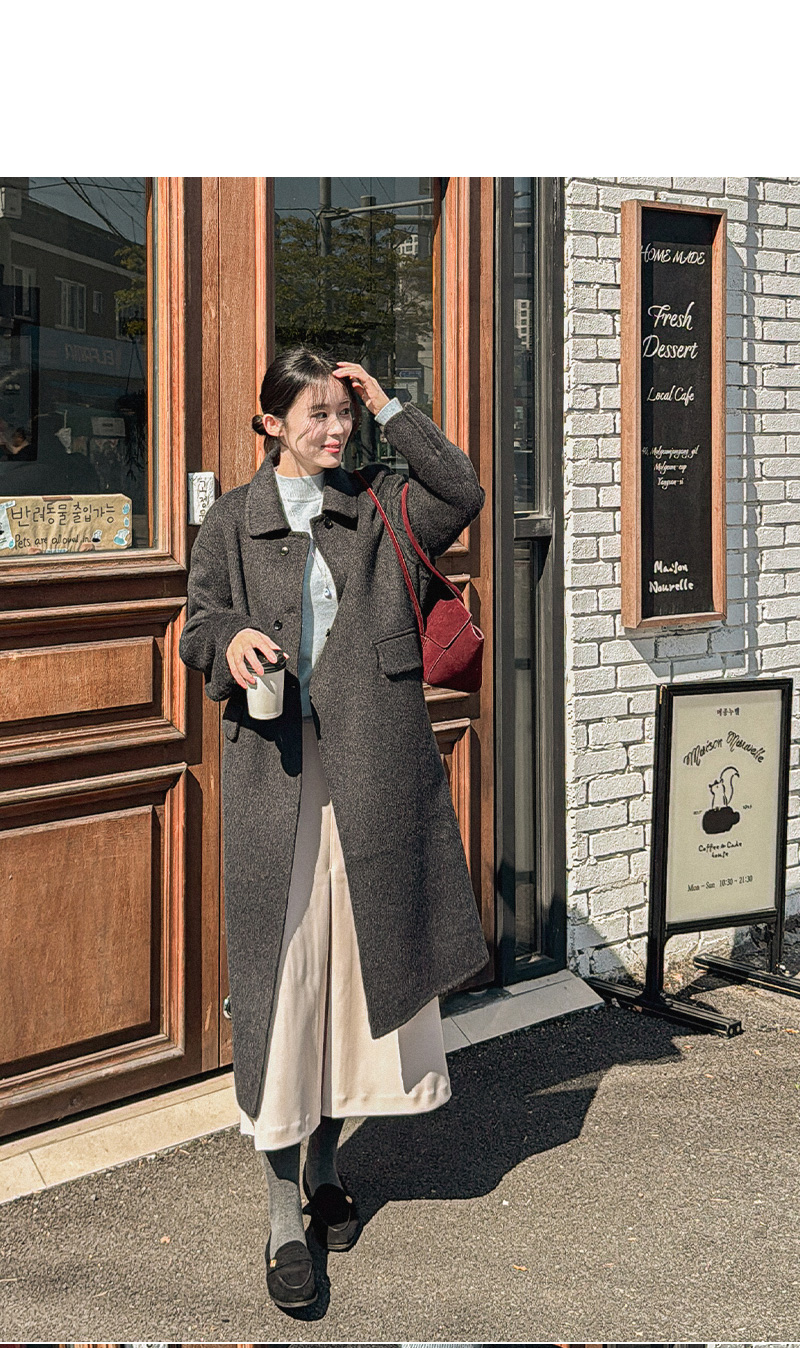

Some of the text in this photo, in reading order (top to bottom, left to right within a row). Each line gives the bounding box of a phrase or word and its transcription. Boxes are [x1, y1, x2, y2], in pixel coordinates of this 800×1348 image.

[641, 242, 706, 265] HOME MADE
[647, 301, 694, 331] Fresh
[642, 334, 699, 360] Dessert
[646, 385, 695, 407] Local Cafe
[10, 501, 116, 528] 반려동물 출입가능
[14, 533, 31, 550] Pets
[34, 537, 48, 546] are
[654, 560, 689, 574] Maison
[683, 738, 723, 767] Maison
[698, 843, 720, 853] Coffee
[687, 884, 700, 892] Mon
[705, 881, 716, 889] Sun
[719, 878, 734, 887] 10:30
[738, 875, 753, 884] 21:30
